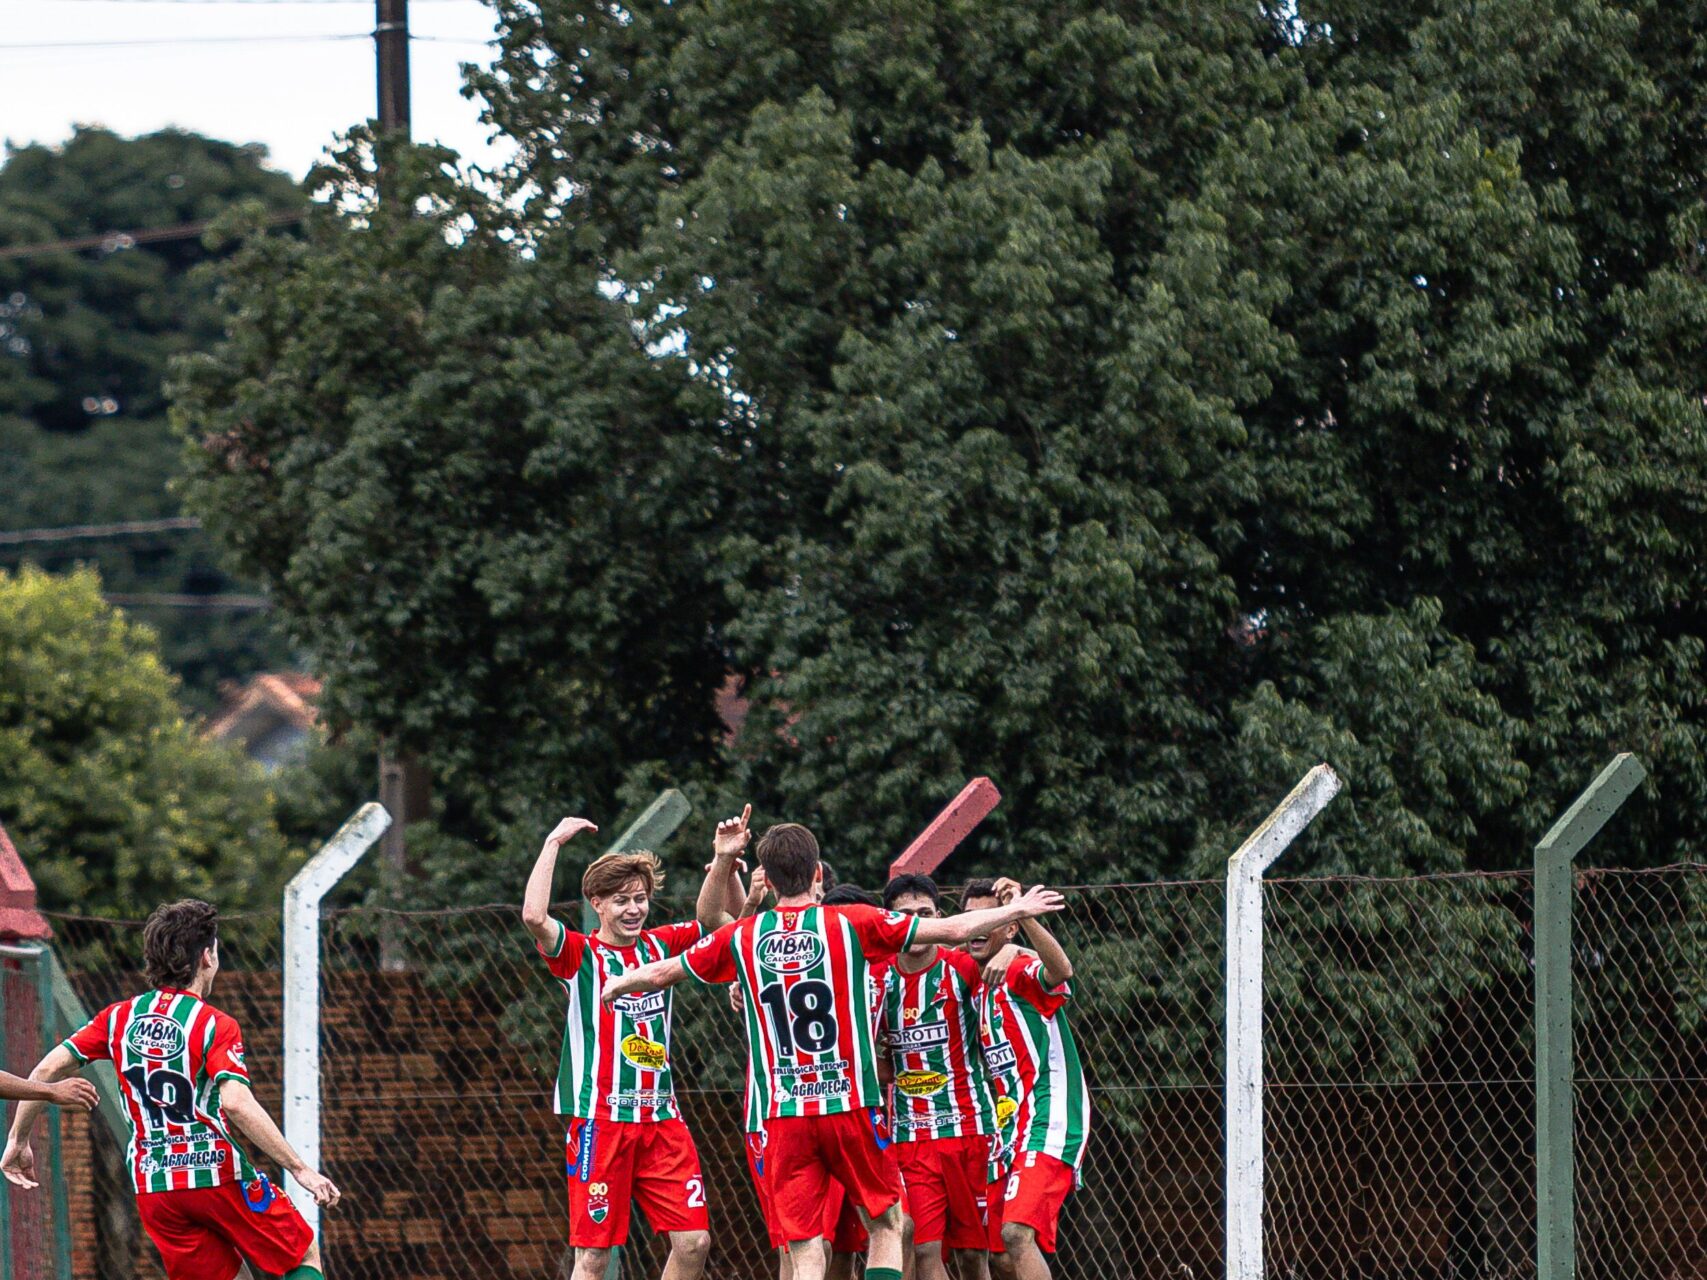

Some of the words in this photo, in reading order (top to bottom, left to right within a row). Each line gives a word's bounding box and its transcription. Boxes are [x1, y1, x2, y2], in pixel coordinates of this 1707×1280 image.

[766, 936, 813, 955] MBM
[766, 954, 813, 962] CALÇADOS
[760, 981, 836, 1056] 18
[136, 1021, 177, 1041] MBM
[686, 1178, 706, 1208] 2
